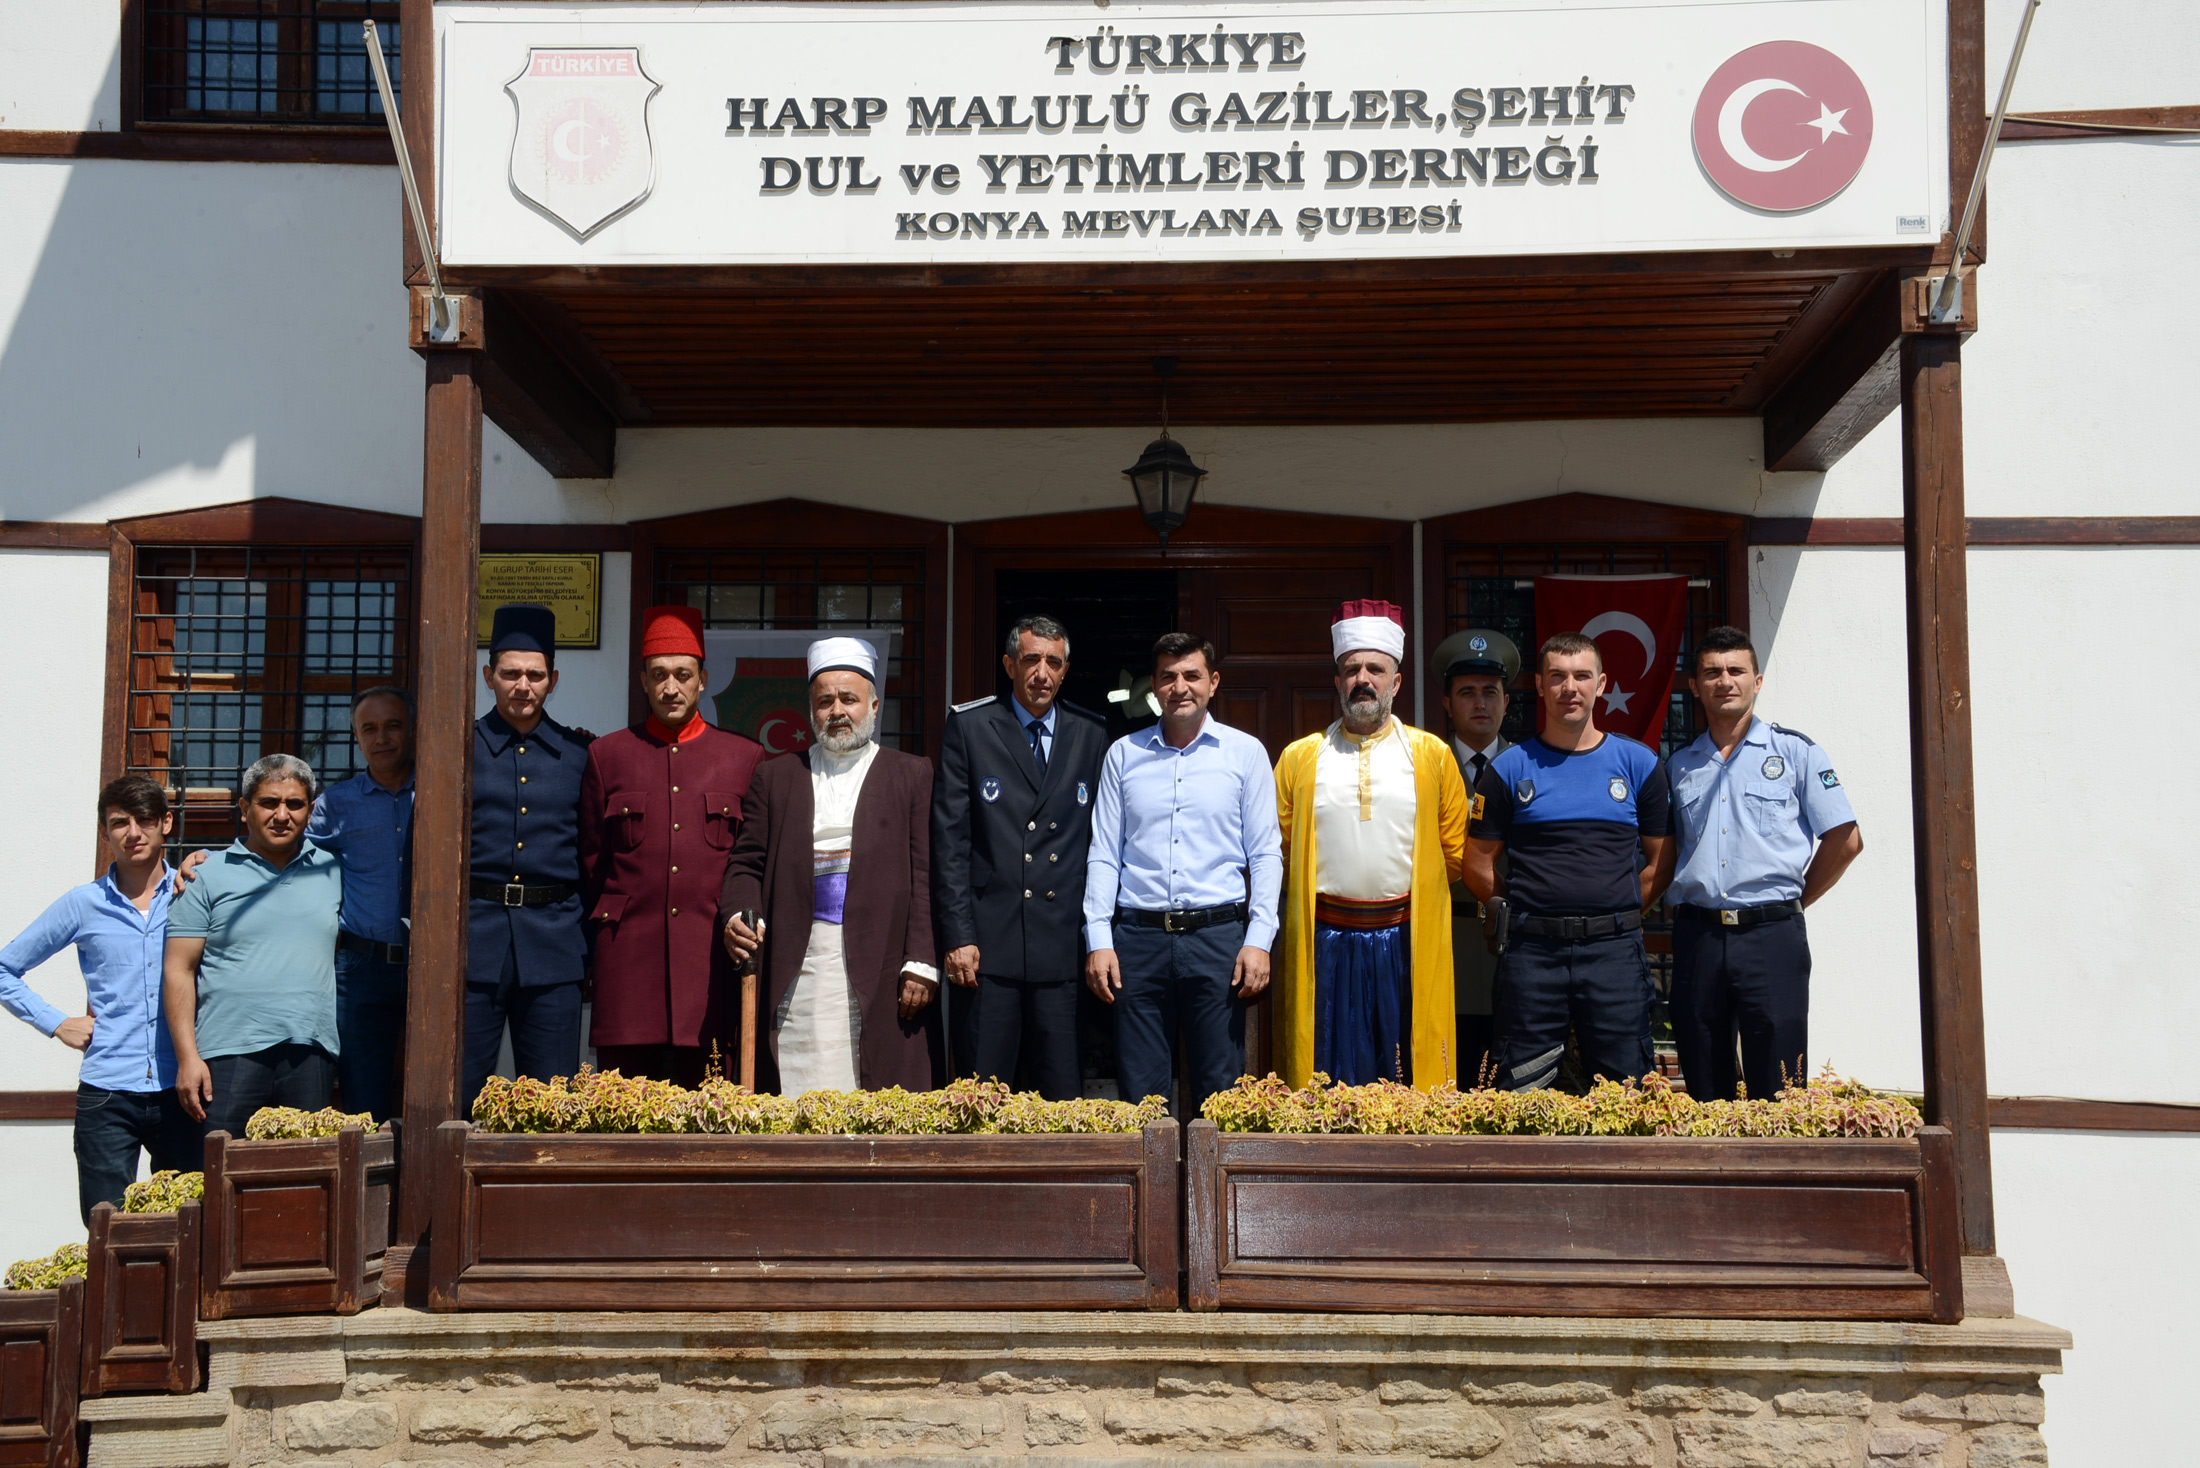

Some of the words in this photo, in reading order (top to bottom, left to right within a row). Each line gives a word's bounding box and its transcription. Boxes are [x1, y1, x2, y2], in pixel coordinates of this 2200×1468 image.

[1047, 23, 1306, 71] TÜRKİYE
[537, 56, 628, 72] TÜRKİYE
[726, 97, 888, 134] HARP
[908, 84, 1149, 132] MALULÜ
[760, 156, 881, 194] DUL
[901, 164, 960, 190] ve
[979, 141, 1305, 190] YETİMLERİ
[1326, 134, 1599, 185] DERNEĞİ
[896, 211, 1047, 236] KONYA
[1064, 208, 1281, 234] MEVLANA
[1298, 199, 1462, 237] ŞUBESİ
[1900, 217, 1926, 227] Renk
[525, 565, 552, 573] TARİHİ
[743, 661, 807, 674] TÜRKİY
